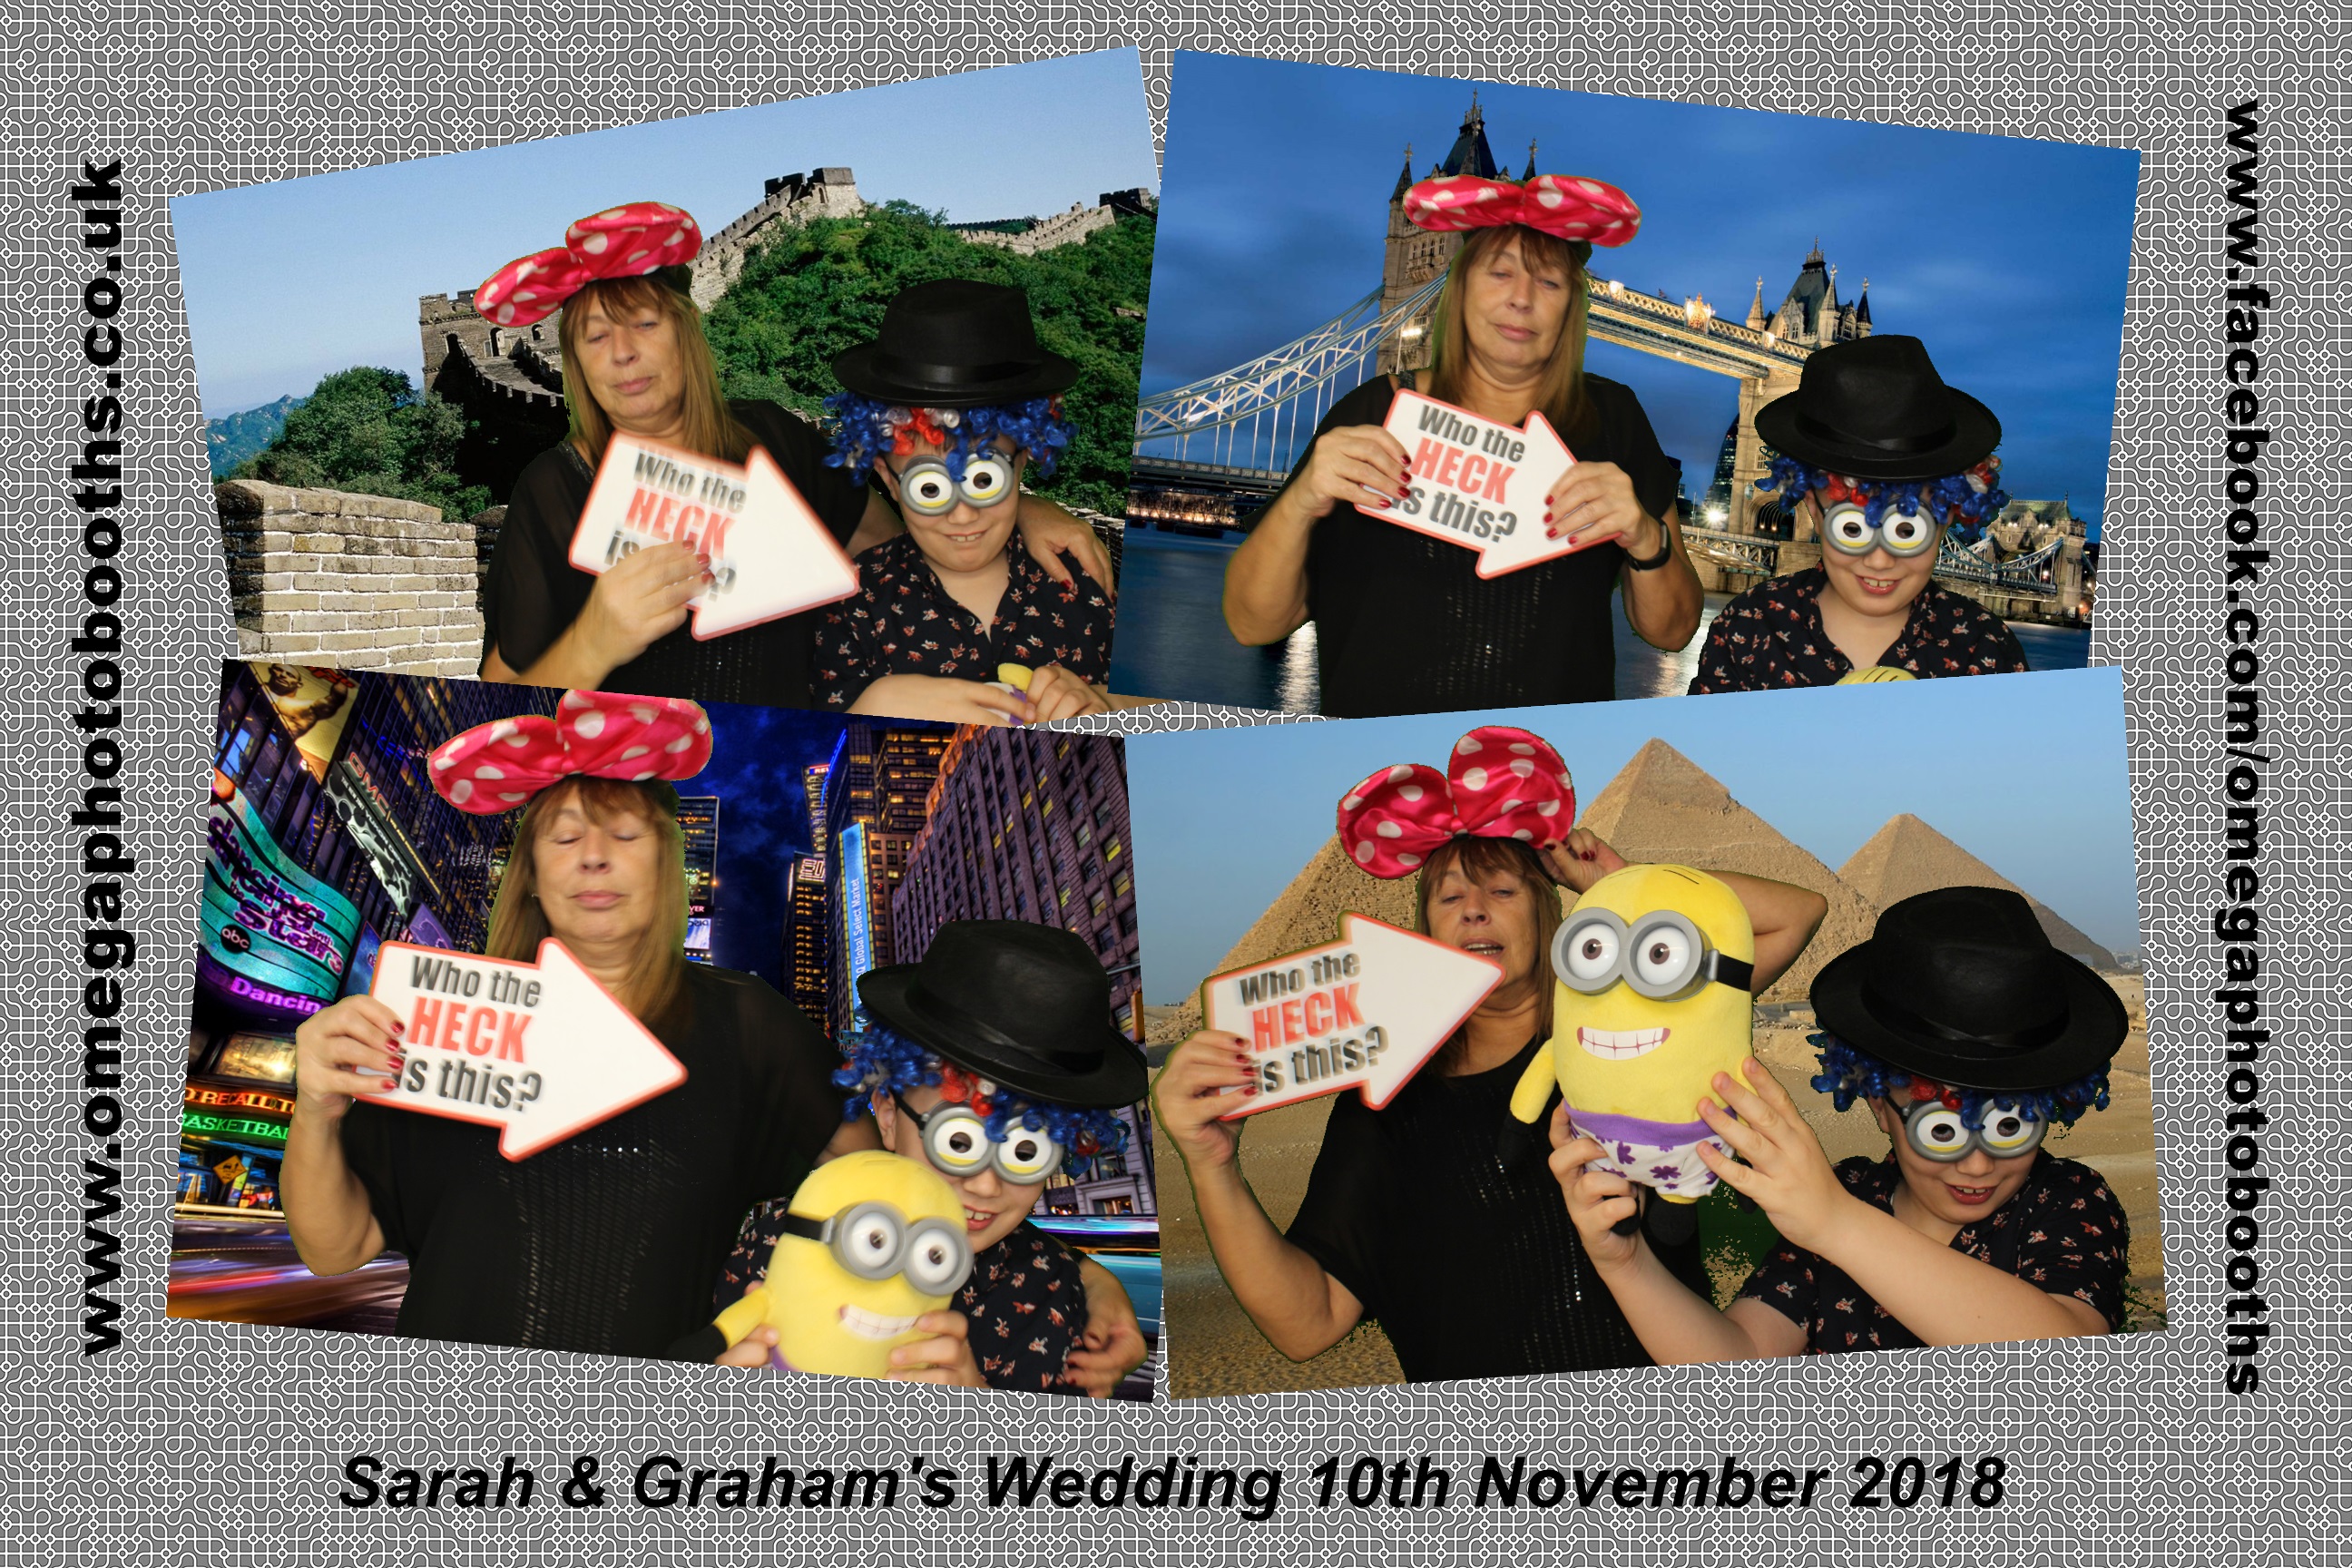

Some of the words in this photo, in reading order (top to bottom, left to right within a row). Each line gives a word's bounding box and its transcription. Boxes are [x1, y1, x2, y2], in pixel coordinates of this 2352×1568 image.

[1416, 404, 1478, 446] Who
[1480, 427, 1526, 463] the
[634, 453, 696, 496] Who
[699, 475, 748, 514] the
[1409, 437, 1516, 505] HECK
[624, 487, 736, 561] HECK
[1429, 490, 1518, 543] this?
[348, 751, 389, 817] GMC
[208, 817, 326, 931] dancing
[850, 877, 861, 907] Market
[221, 926, 250, 949] abc
[233, 898, 344, 975] Stars
[853, 908, 863, 936] Select
[410, 956, 481, 997] Who
[487, 970, 542, 1007] the
[855, 937, 866, 968] Global
[1240, 966, 1306, 1006] Who
[1311, 952, 1361, 986] the
[230, 975, 322, 1014] Dancin
[1252, 983, 1366, 1053] HECK
[407, 996, 533, 1063] HECK
[436, 1059, 542, 1112] this?
[1252, 1057, 1285, 1096] is
[1291, 1024, 1389, 1085] this?
